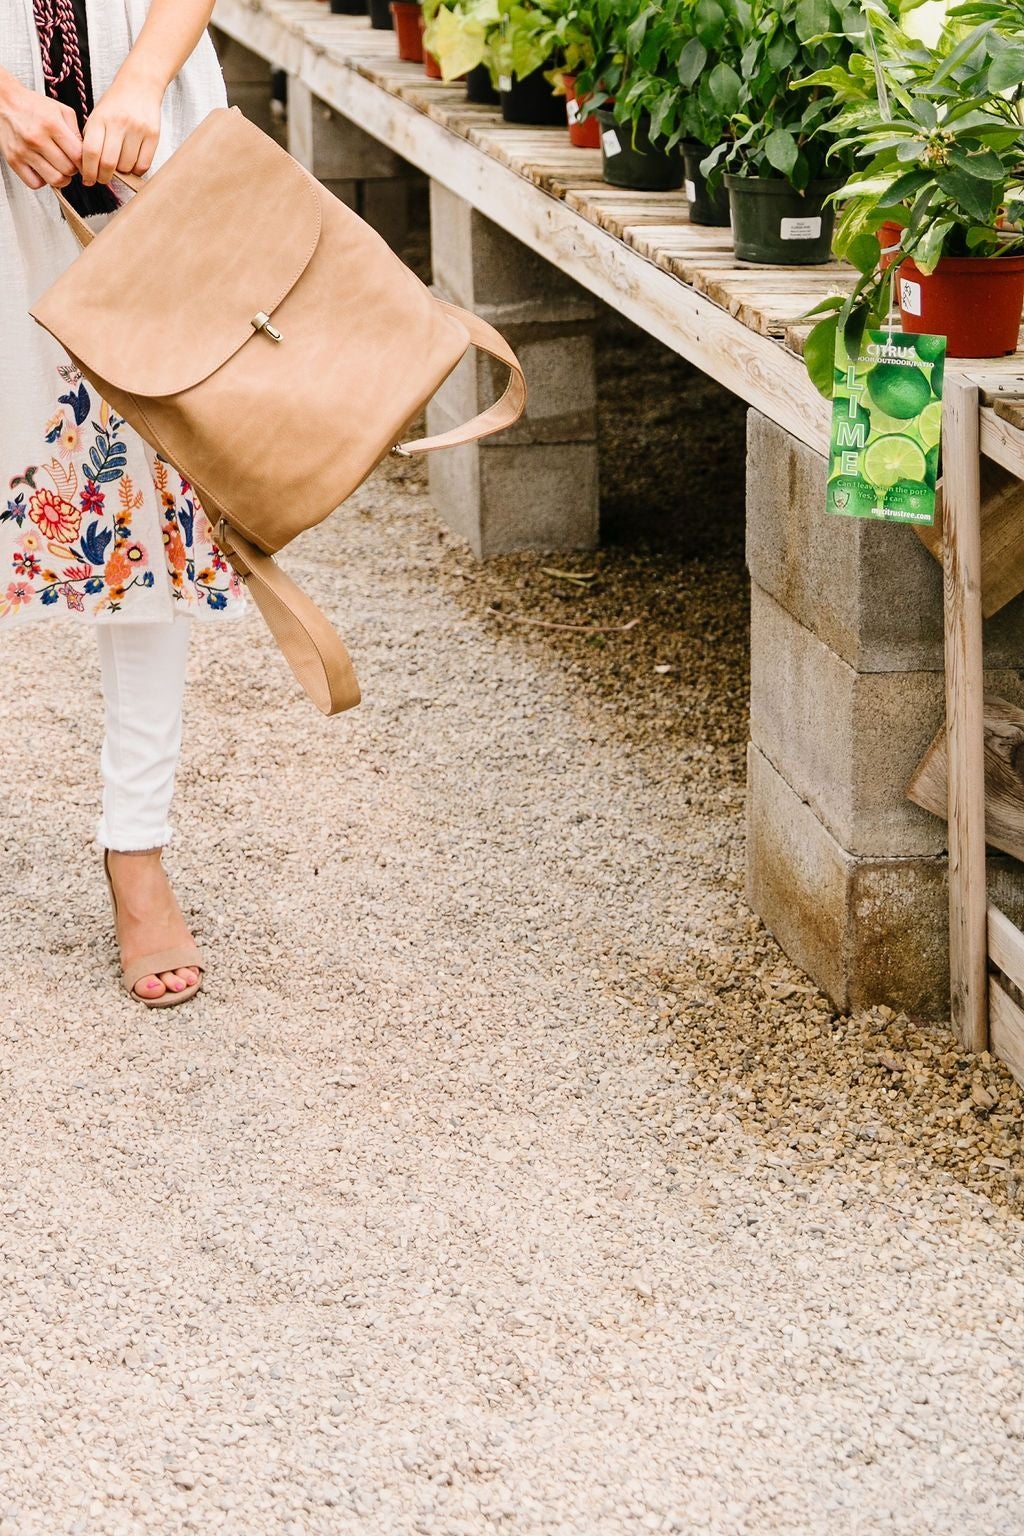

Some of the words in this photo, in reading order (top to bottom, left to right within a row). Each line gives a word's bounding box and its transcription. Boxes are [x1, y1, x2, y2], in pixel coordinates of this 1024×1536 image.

[866, 344, 916, 359] CITRUS
[847, 355, 935, 368] IOOR/OUTDOOR/PATIO
[836, 365, 865, 476] LIME
[837, 479, 852, 488] Can
[895, 486, 908, 494] the
[871, 507, 931, 521] mycitrustree.com
